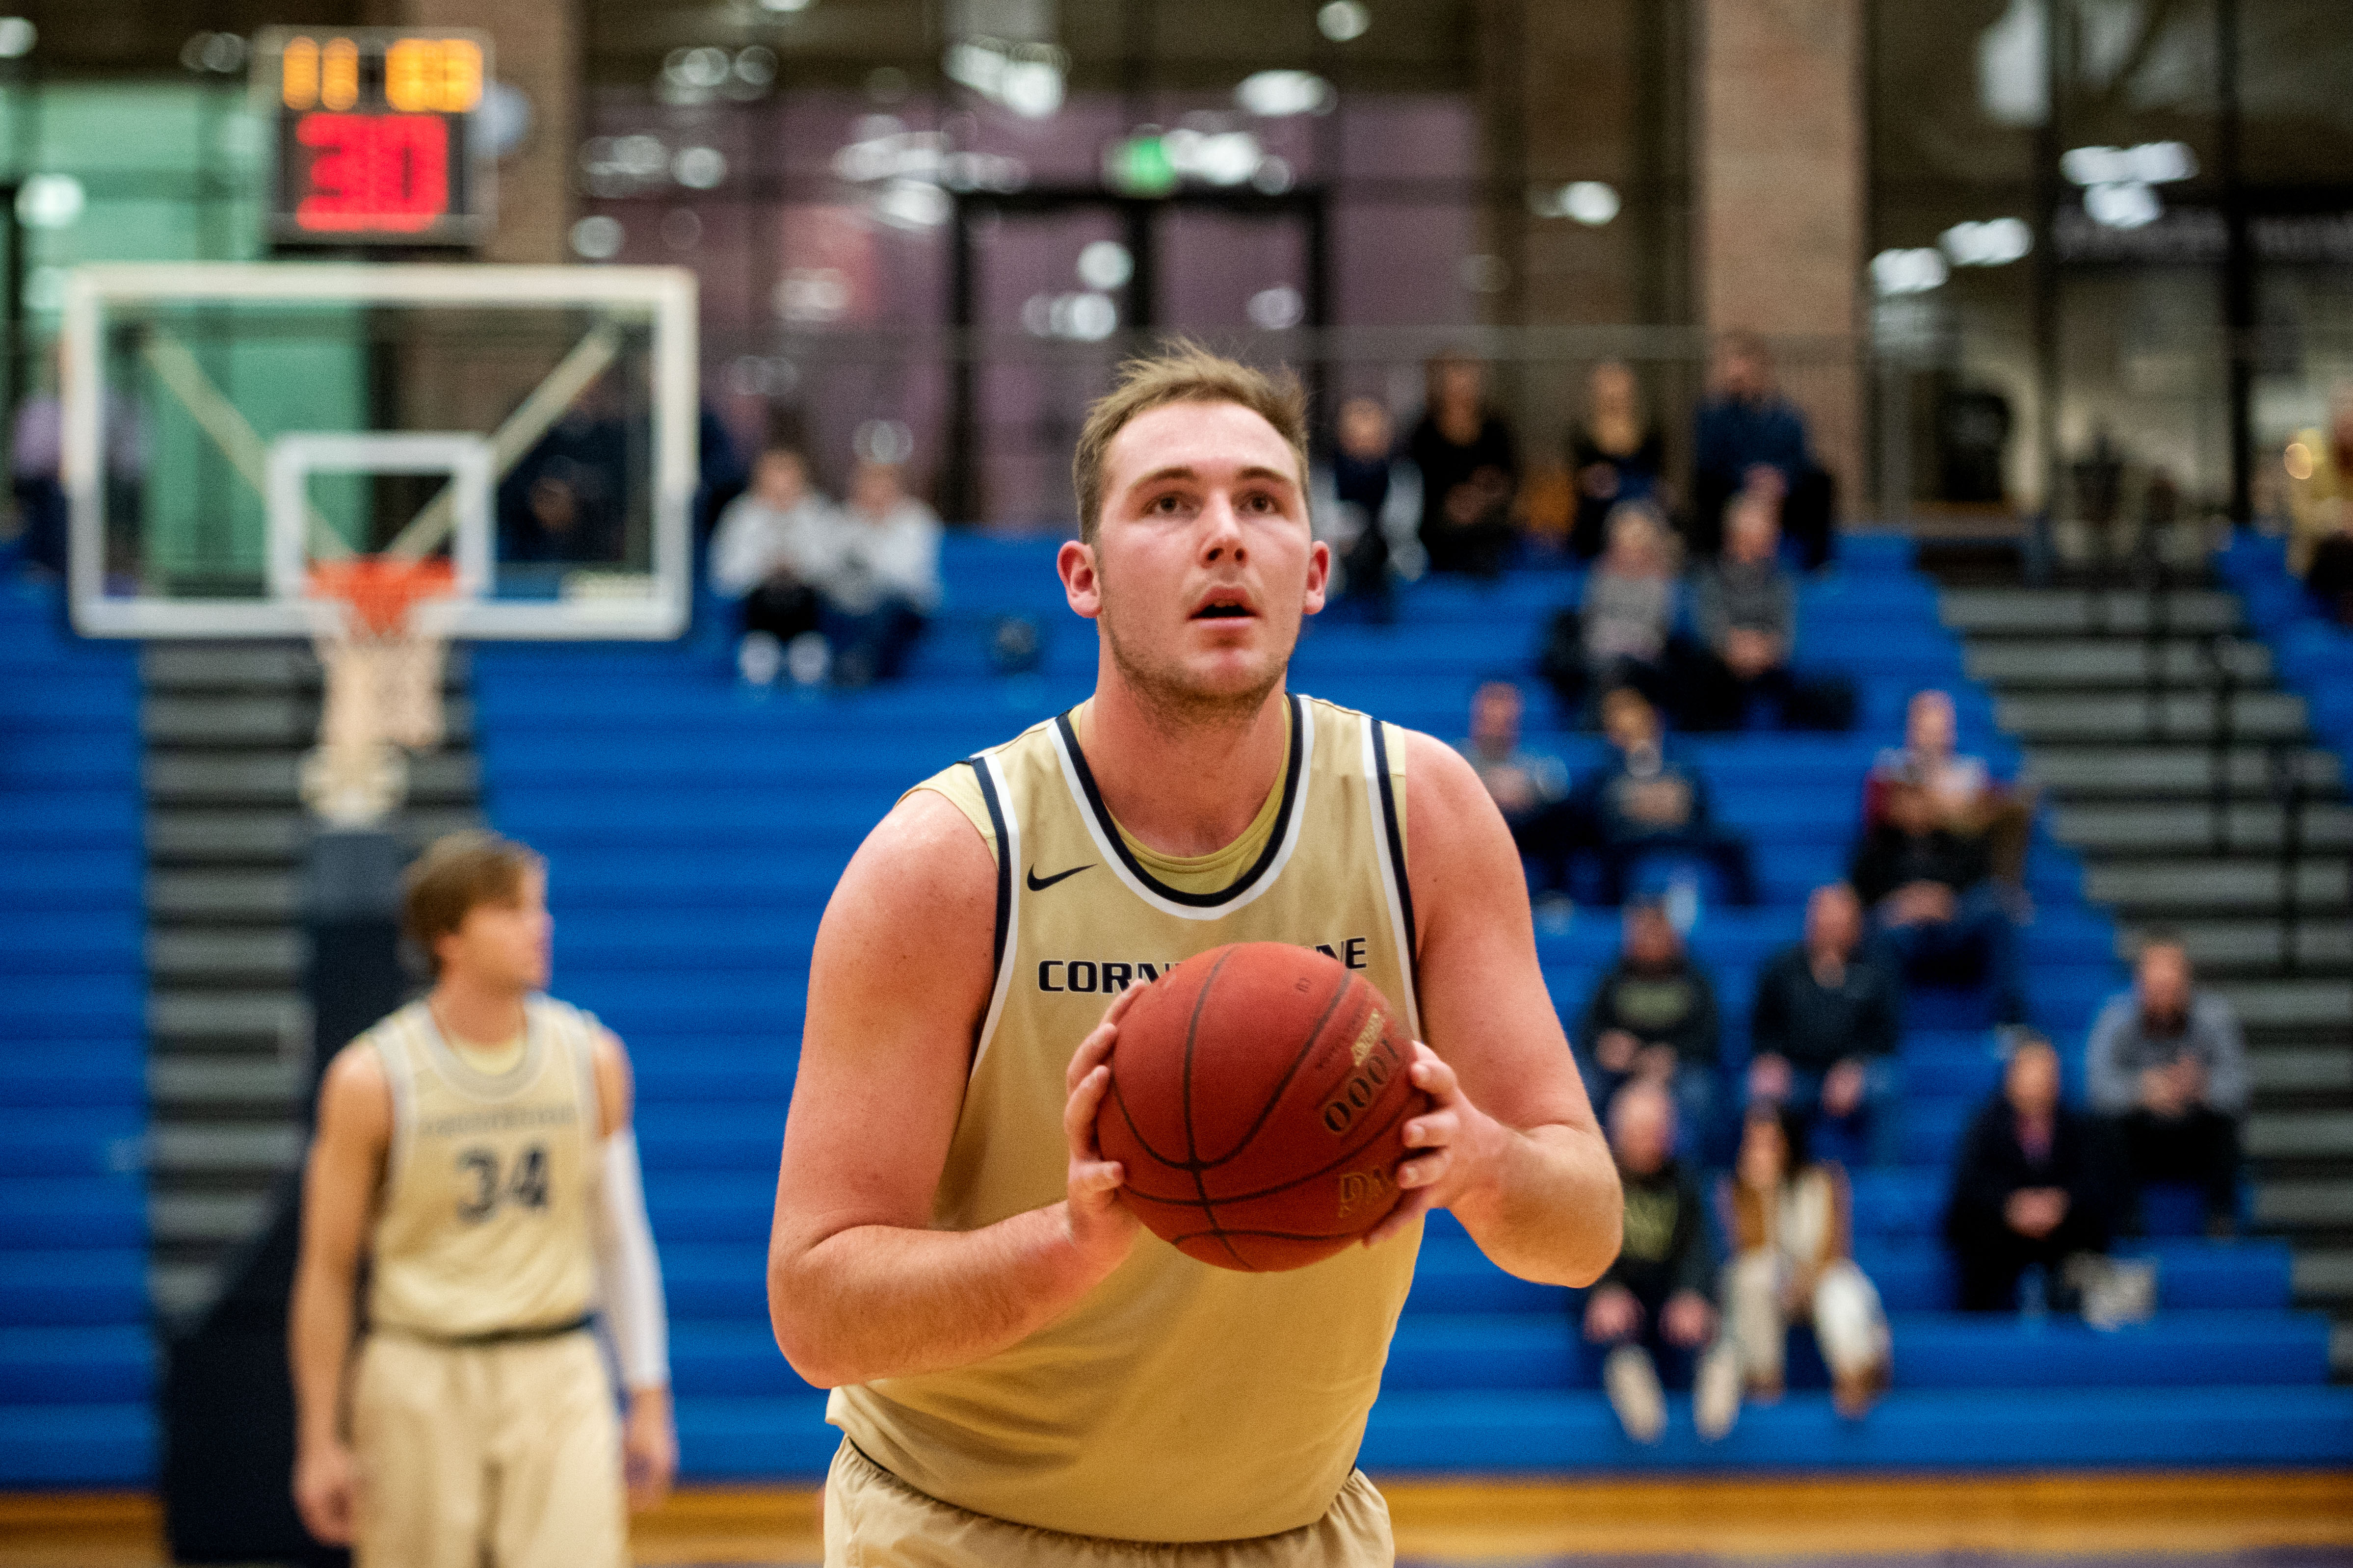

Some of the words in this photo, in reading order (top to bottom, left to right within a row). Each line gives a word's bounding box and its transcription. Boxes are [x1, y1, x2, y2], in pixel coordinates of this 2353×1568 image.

[296, 112, 449, 232] 30
[1038, 937, 1367, 993] CORNNE
[455, 1141, 550, 1224] 34
